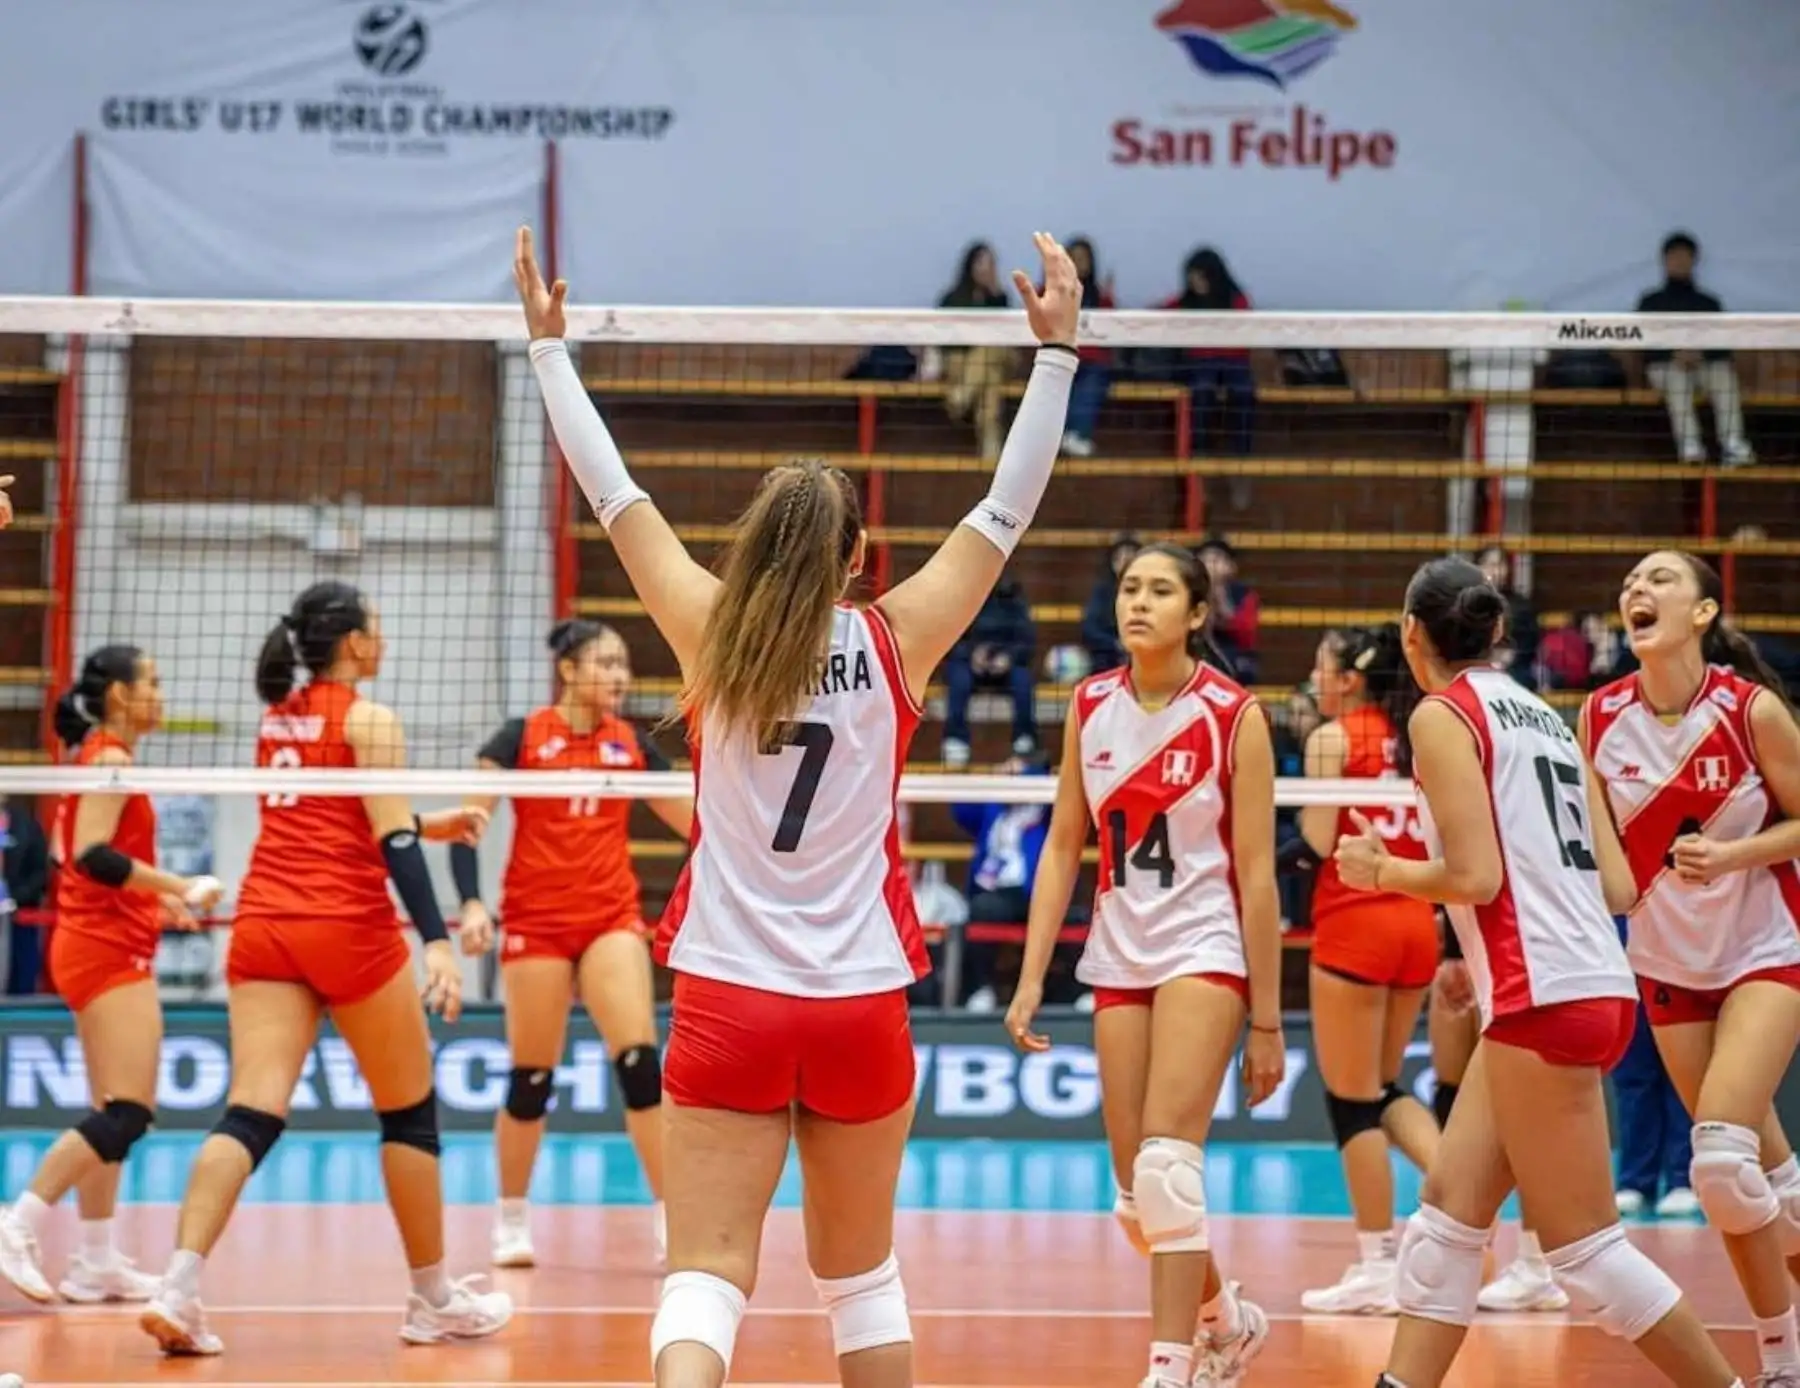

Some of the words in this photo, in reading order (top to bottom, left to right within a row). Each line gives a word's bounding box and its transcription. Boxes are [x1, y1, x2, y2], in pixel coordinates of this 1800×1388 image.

[102, 97, 208, 131] GIRLS'
[219, 101, 282, 133] U17
[296, 102, 413, 134] WORLD
[424, 104, 674, 140] CHAMPIONSHIP
[1111, 118, 1212, 166] San
[1230, 103, 1397, 181] Felipe
[757, 720, 834, 853] 7
[1108, 809, 1175, 889] 14
